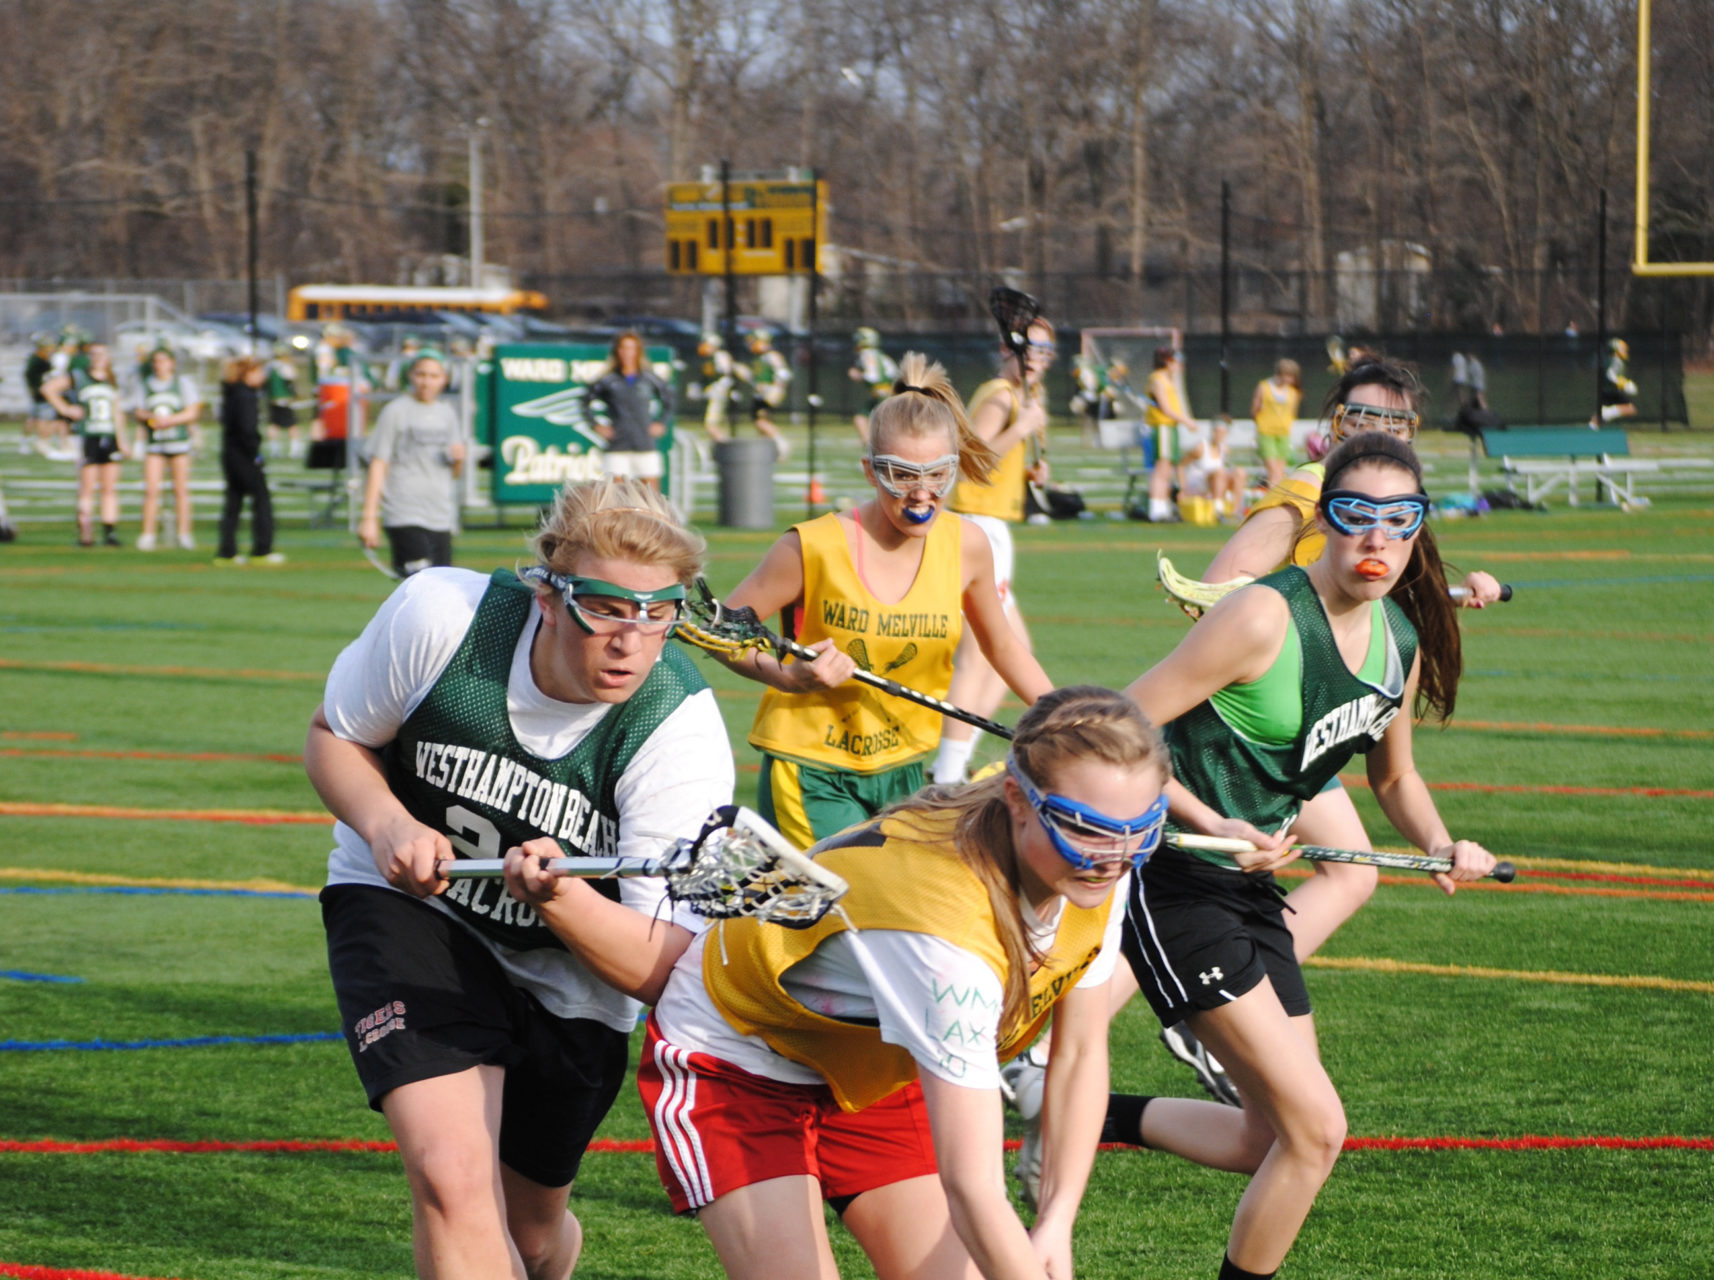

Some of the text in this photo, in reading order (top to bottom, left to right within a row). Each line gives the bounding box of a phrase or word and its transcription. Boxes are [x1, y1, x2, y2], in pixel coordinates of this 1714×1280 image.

[500, 357, 568, 383] WARD
[500, 434, 606, 487] Patriot
[823, 600, 948, 639] WARD MELVILLE
[415, 741, 617, 857] WESTHAMPTON BEAH
[925, 1008, 986, 1045] LAX
